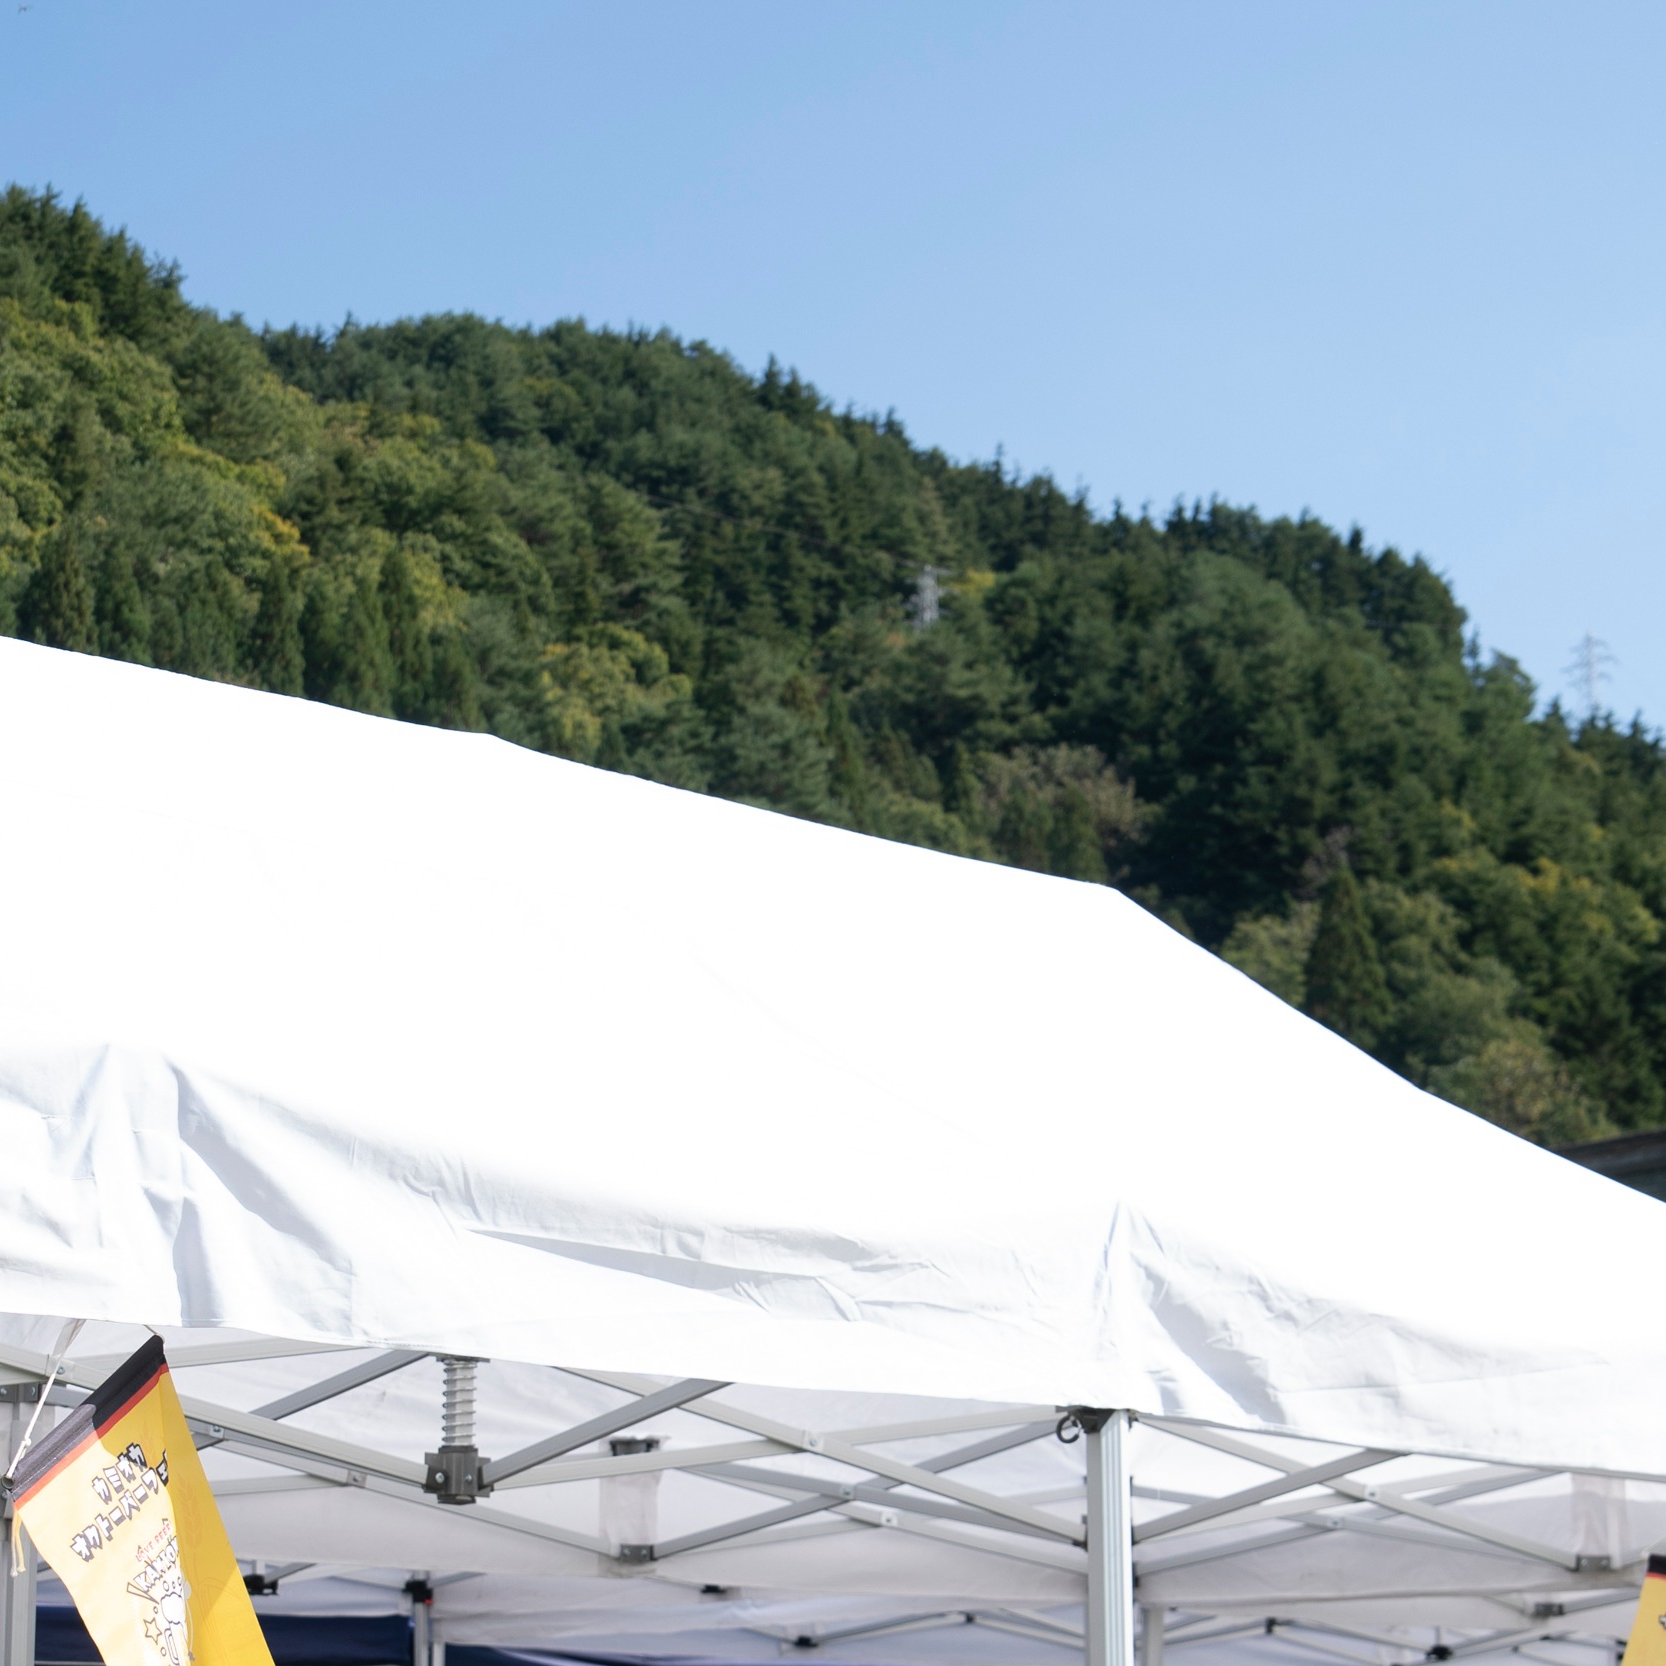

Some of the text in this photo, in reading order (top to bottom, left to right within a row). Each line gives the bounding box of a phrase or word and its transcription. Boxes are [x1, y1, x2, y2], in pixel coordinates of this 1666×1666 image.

[70, 1448, 169, 1563] オクトーバーフェ
[91, 1442, 148, 1505] カミオカ
